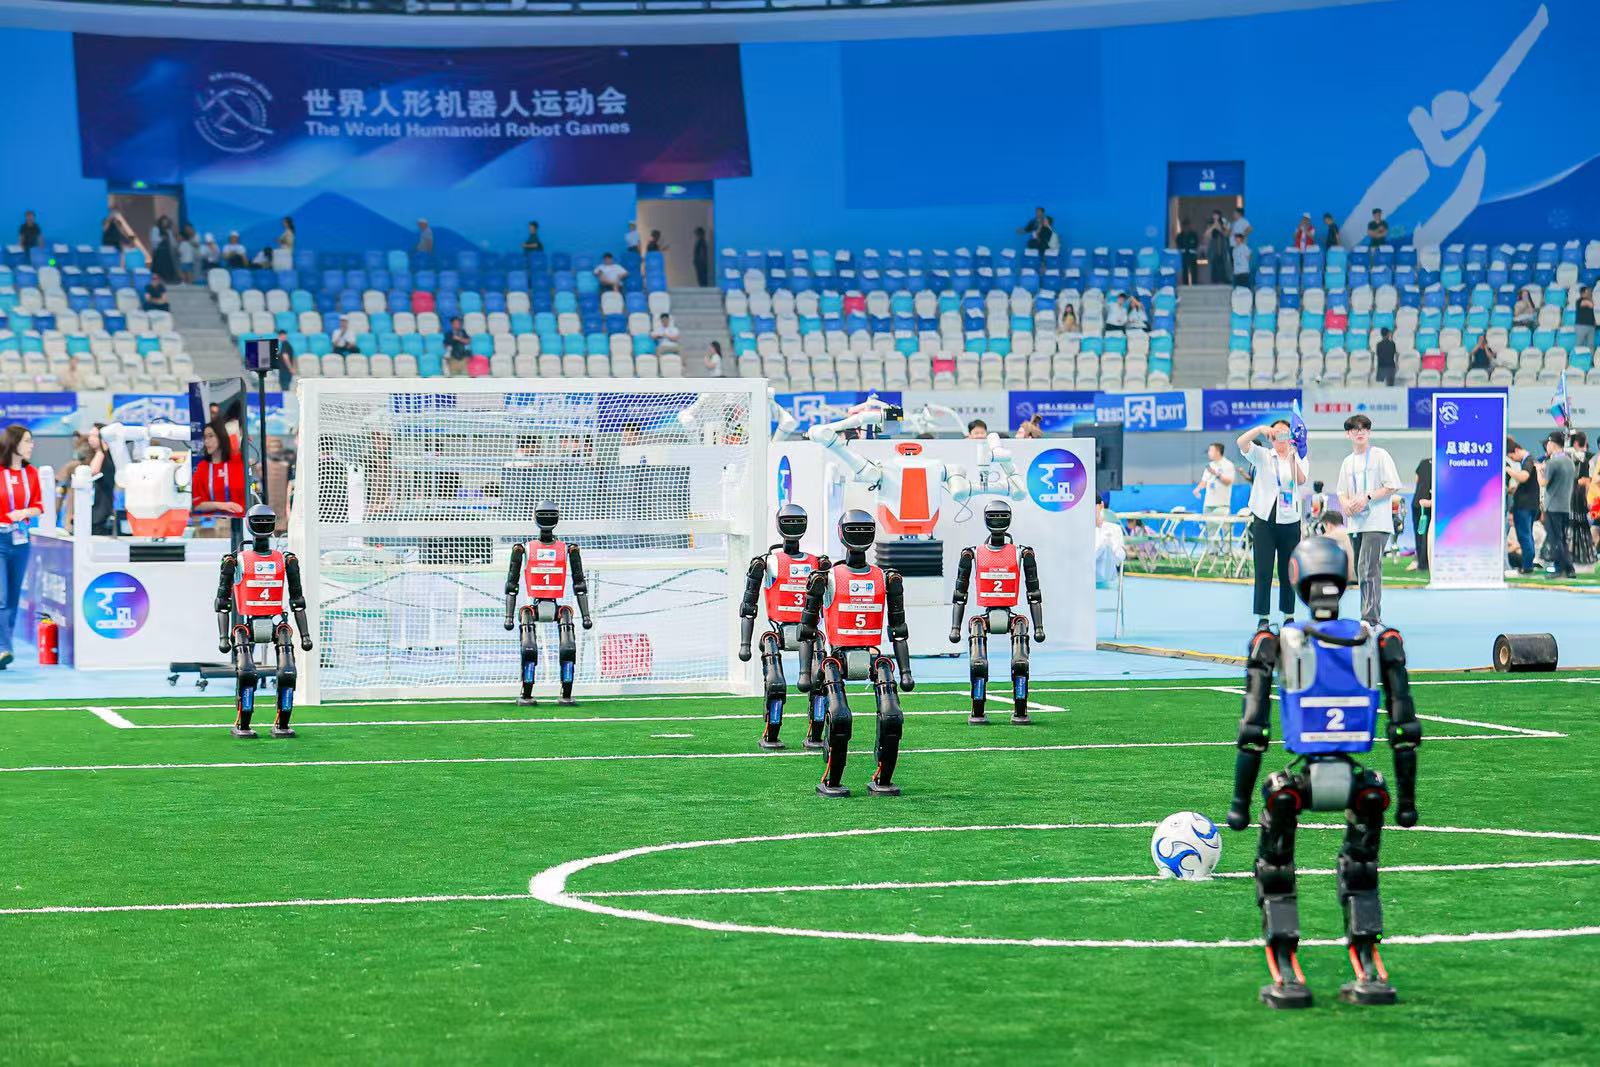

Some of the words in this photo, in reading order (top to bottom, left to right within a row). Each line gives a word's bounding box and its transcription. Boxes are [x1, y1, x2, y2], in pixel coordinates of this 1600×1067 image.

[302, 86, 627, 118] 世界人形机器人运动会
[304, 120, 340, 136] The
[345, 121, 401, 137] World
[406, 122, 501, 137] Humanoid
[506, 122, 562, 137] Robot
[565, 120, 631, 136] Games
[1156, 403, 1185, 421] EXIT
[1446, 440, 1493, 455] 足球3v3
[542, 574, 550, 585] 1
[993, 580, 1003, 592] 2
[259, 588, 270, 600] 4
[793, 593, 804, 606] 3
[855, 613, 867, 628] 5
[1325, 707, 1346, 731] 2
